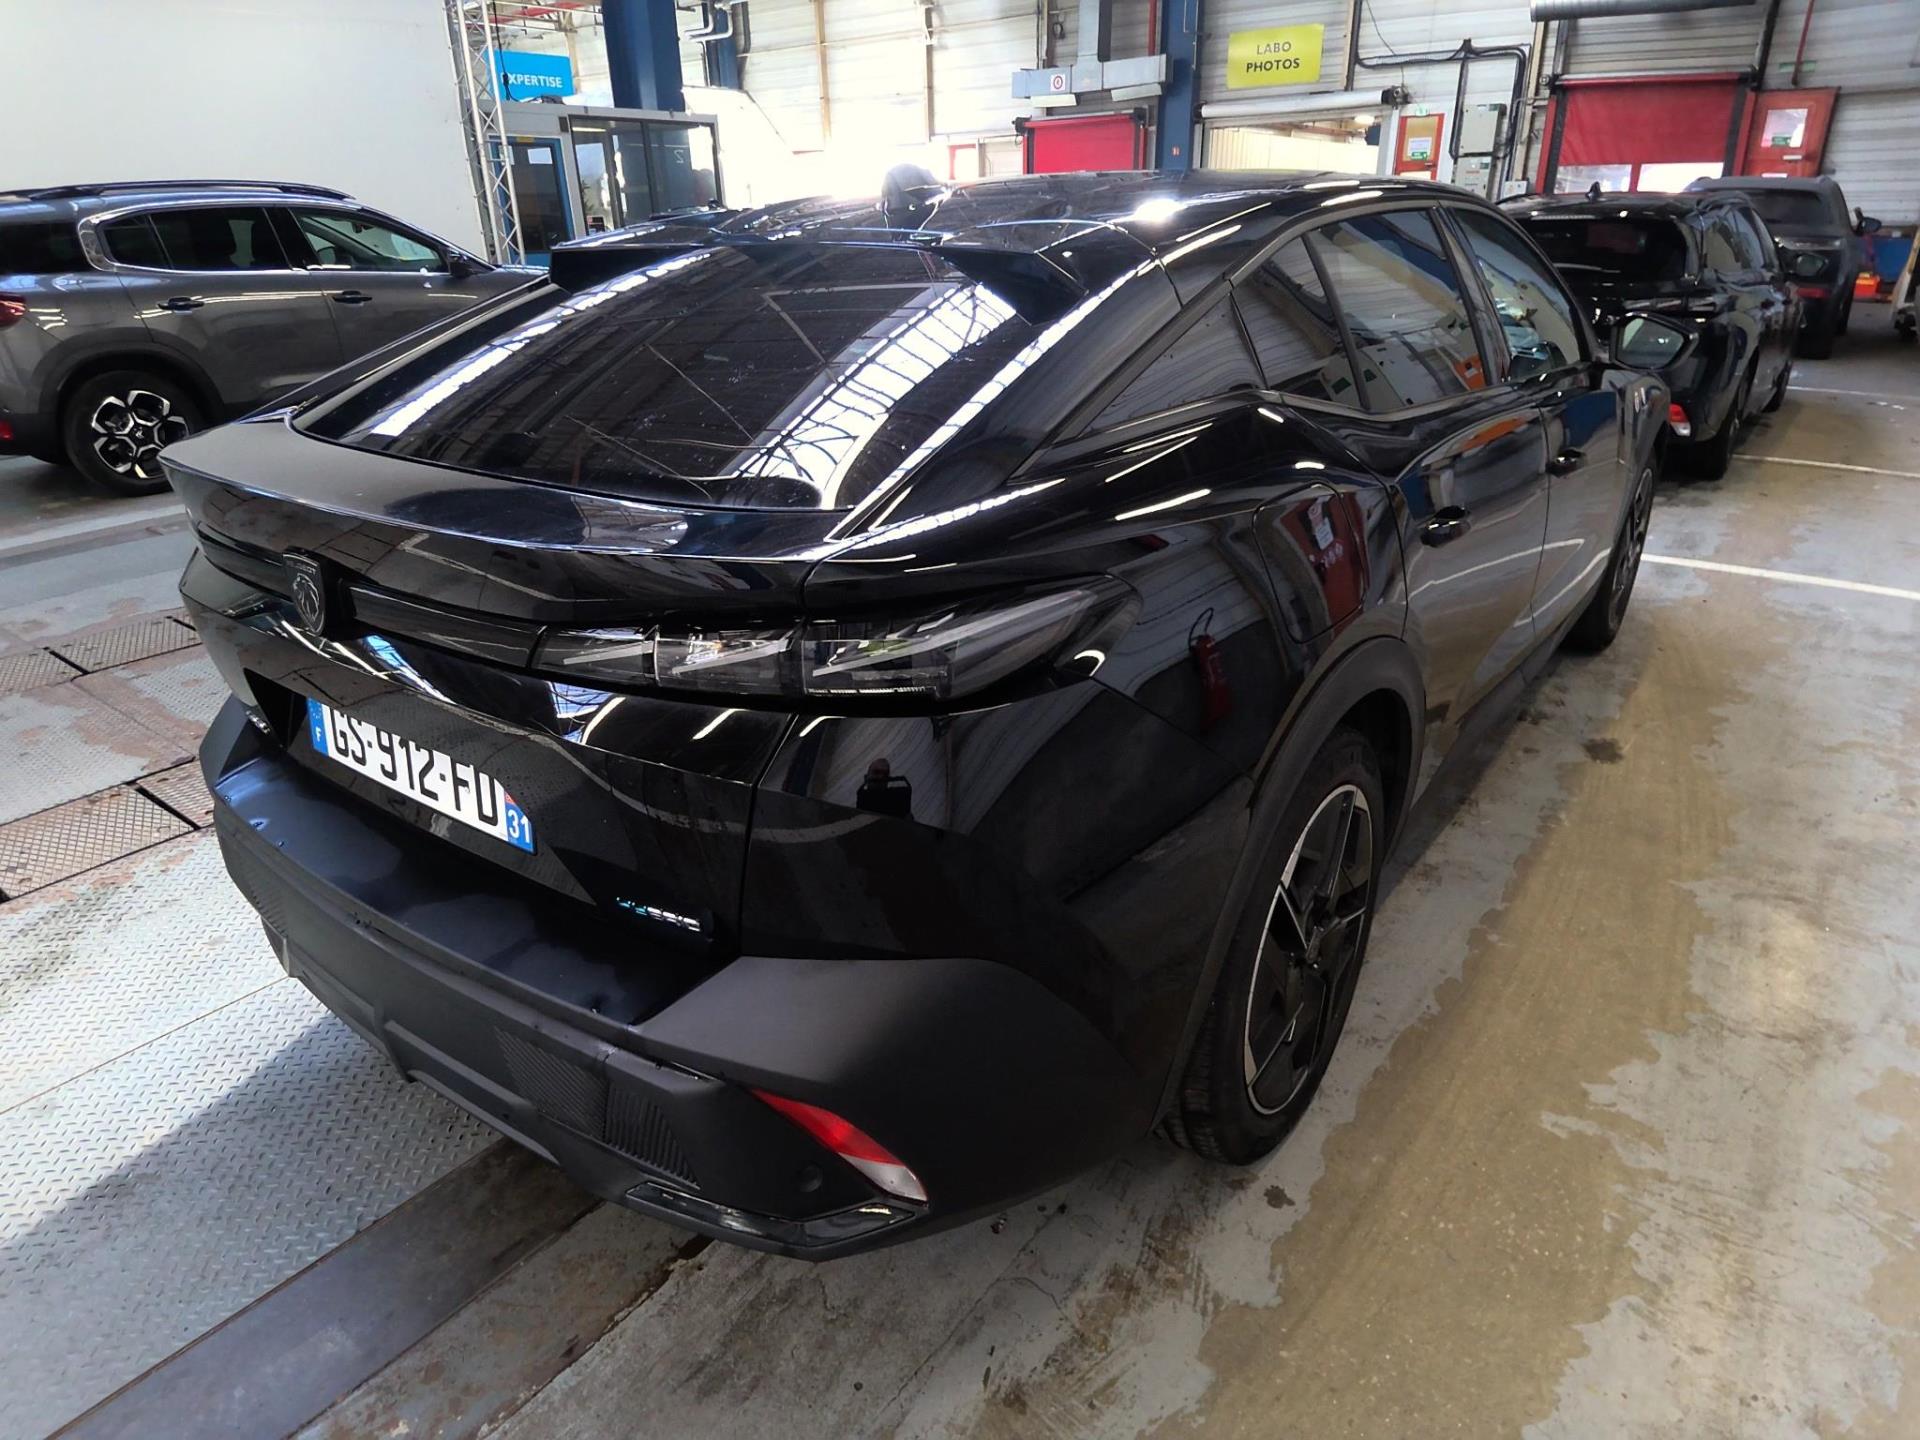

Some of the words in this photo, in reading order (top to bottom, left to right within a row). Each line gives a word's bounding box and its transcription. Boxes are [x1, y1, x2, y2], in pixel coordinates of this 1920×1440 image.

[1257, 41, 1292, 55] LABO
[1246, 58, 1300, 73] PHOTOS
[315, 727, 322, 742] F
[507, 809, 530, 844] 31
